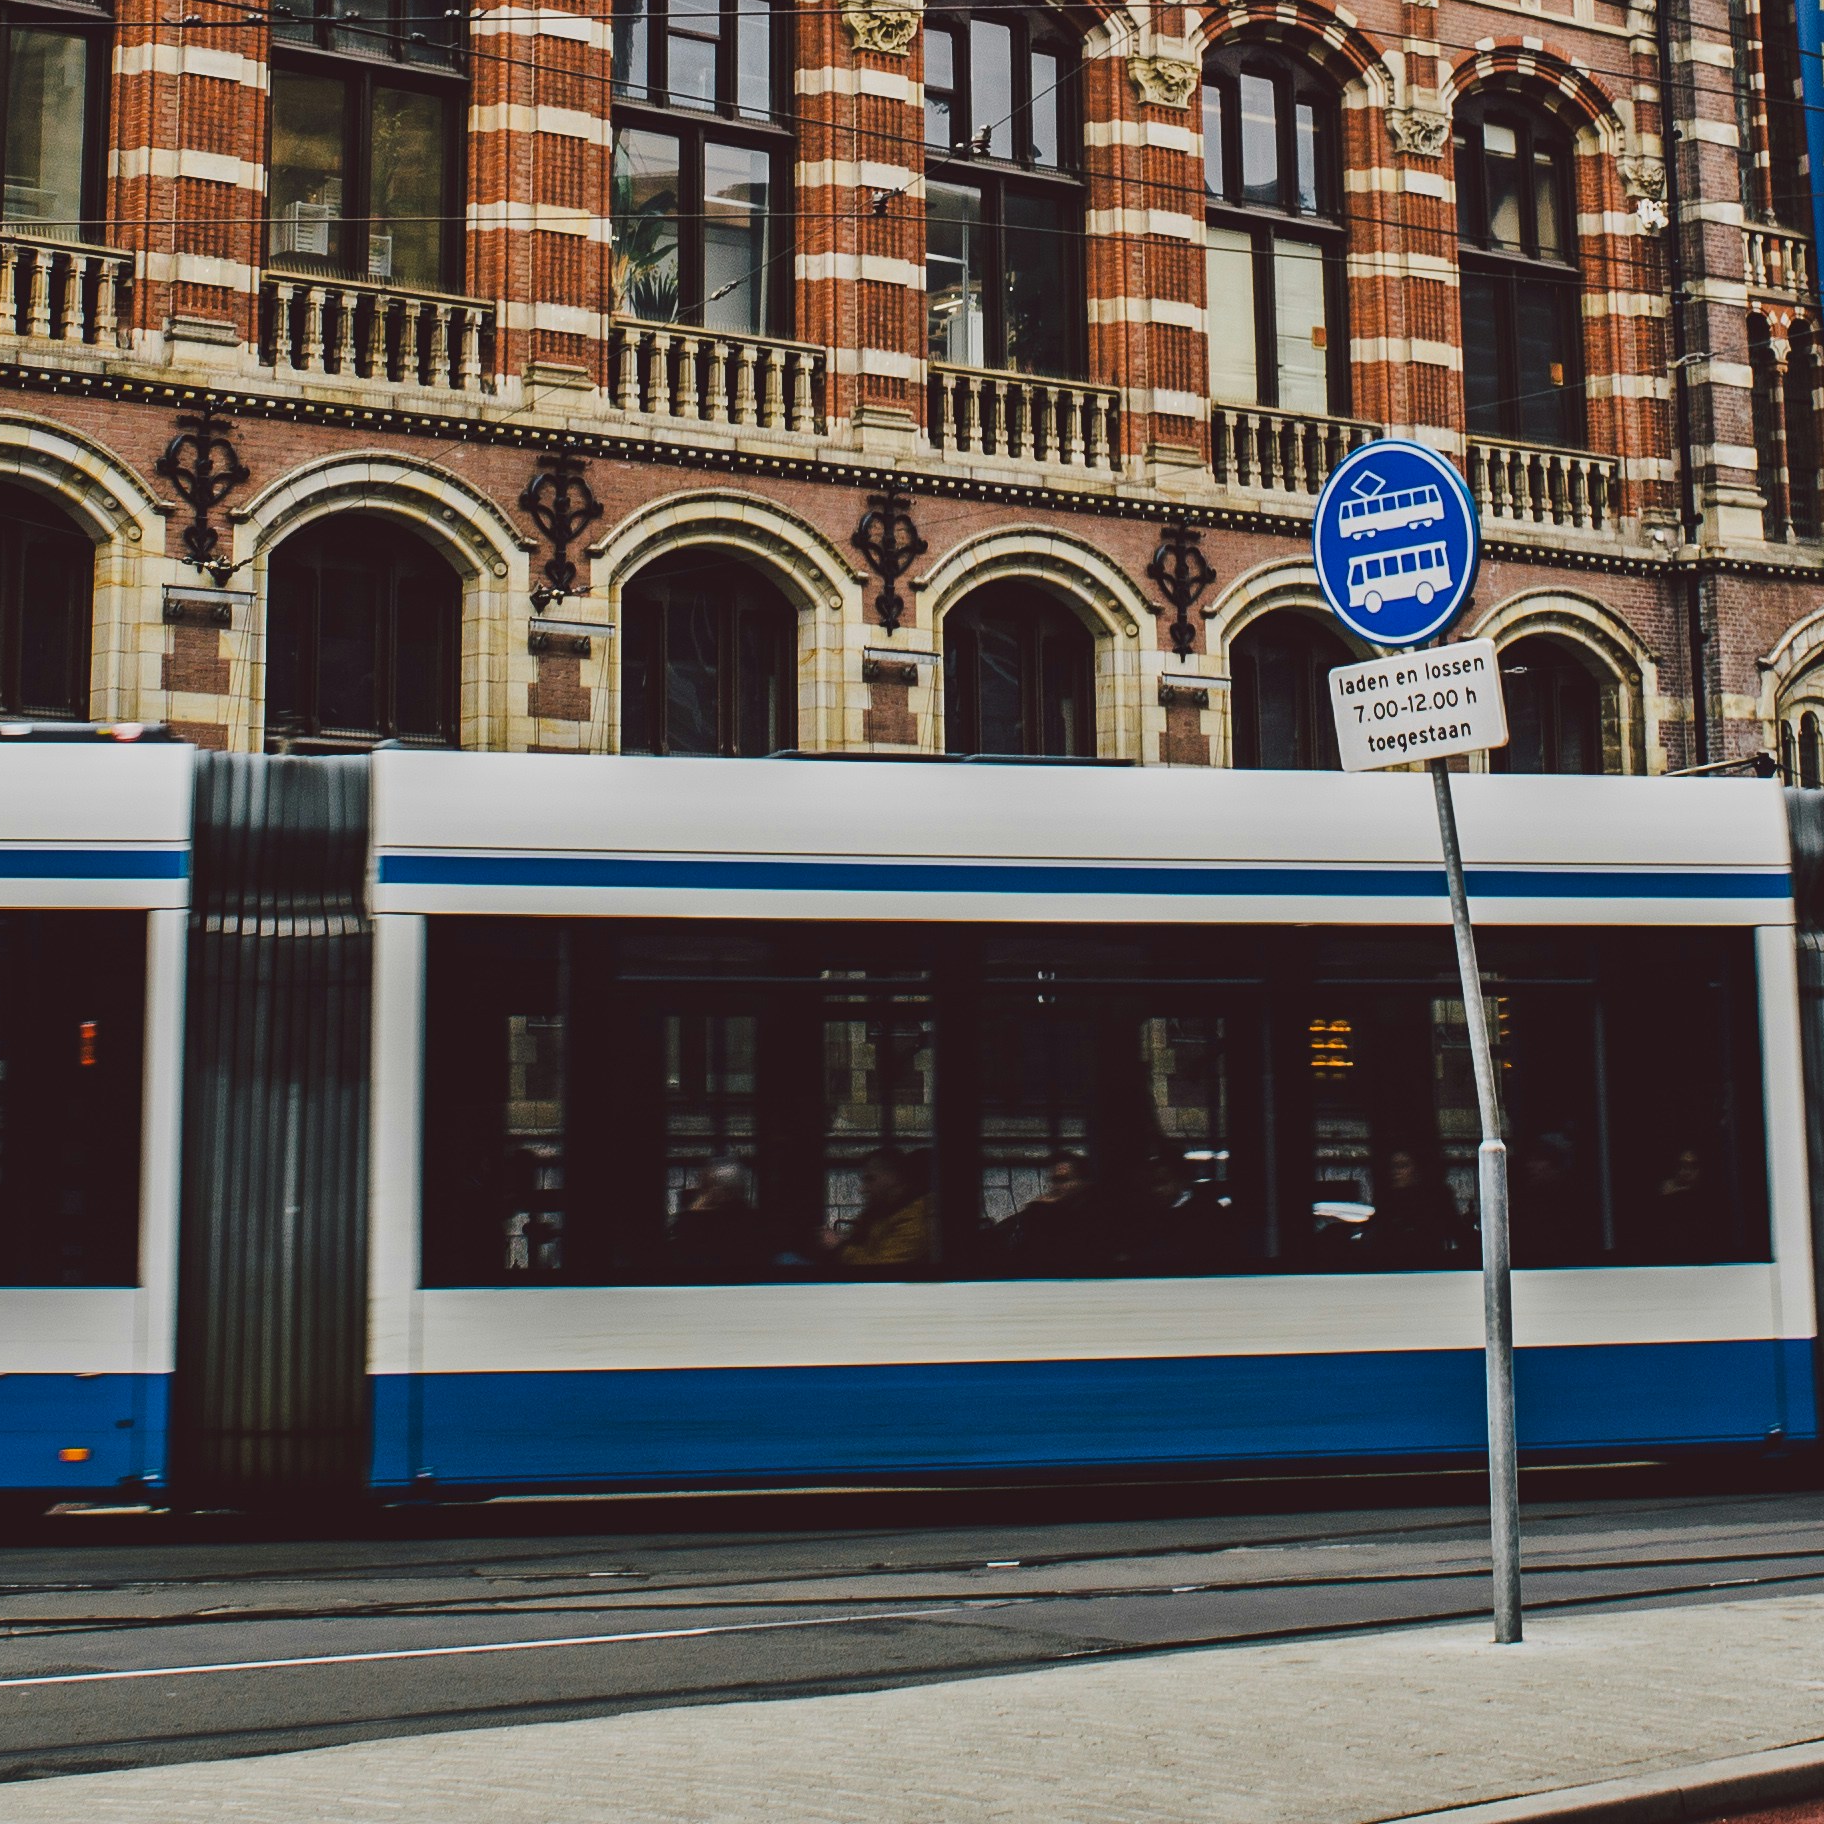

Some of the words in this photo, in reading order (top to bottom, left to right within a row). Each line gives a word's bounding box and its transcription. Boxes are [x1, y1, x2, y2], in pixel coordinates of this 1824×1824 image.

[1338, 675, 1389, 696] laden
[1396, 667, 1418, 687] en
[1425, 655, 1485, 680] lossen
[1353, 689, 1459, 723] 7.00-12.00
[1465, 686, 1477, 704] h
[1367, 722, 1473, 753] toegestaan
